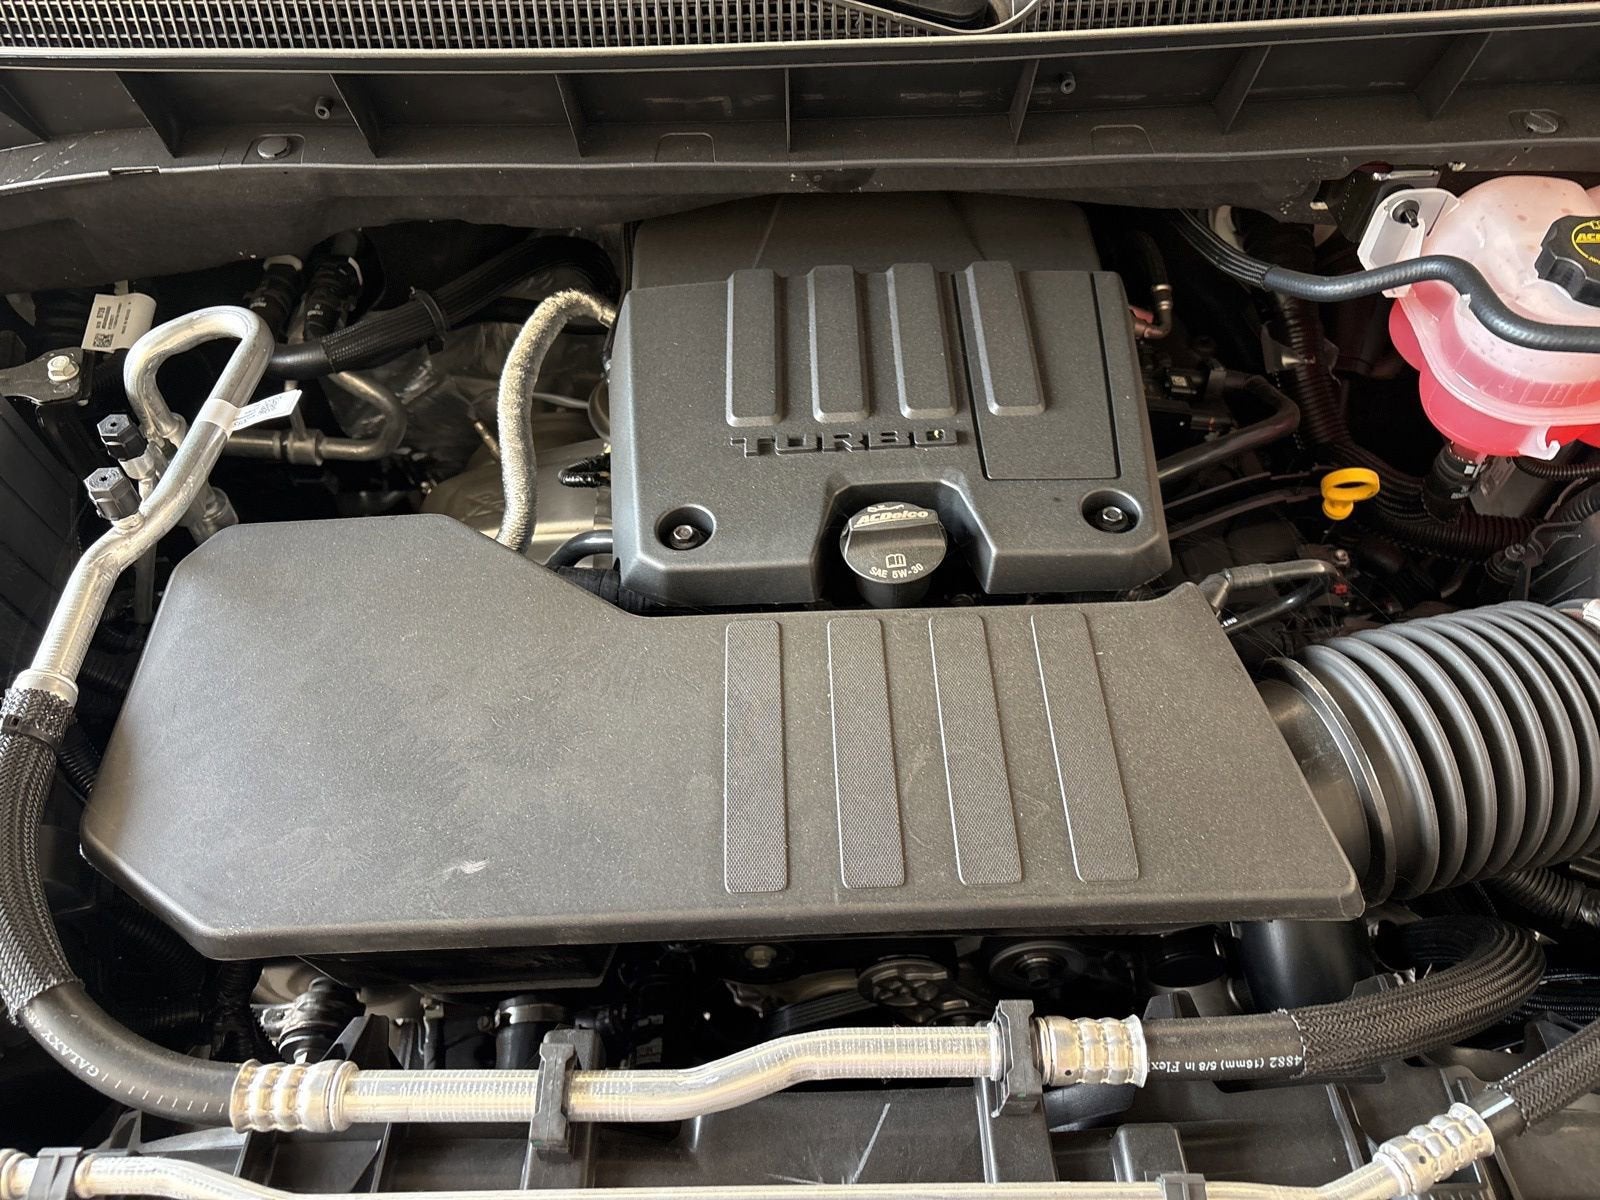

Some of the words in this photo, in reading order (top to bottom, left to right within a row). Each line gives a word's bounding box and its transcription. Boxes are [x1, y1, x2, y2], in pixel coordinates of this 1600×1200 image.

[730, 428, 960, 458] TURBO
[855, 510, 929, 526] ACDelco
[869, 566, 889, 578] SAE
[892, 562, 924, 579] 5W-30
[40, 1028, 100, 1077] GALAXY
[1220, 1057, 1265, 1070] (16mm)
[1269, 1055, 1303, 1069] 4882
